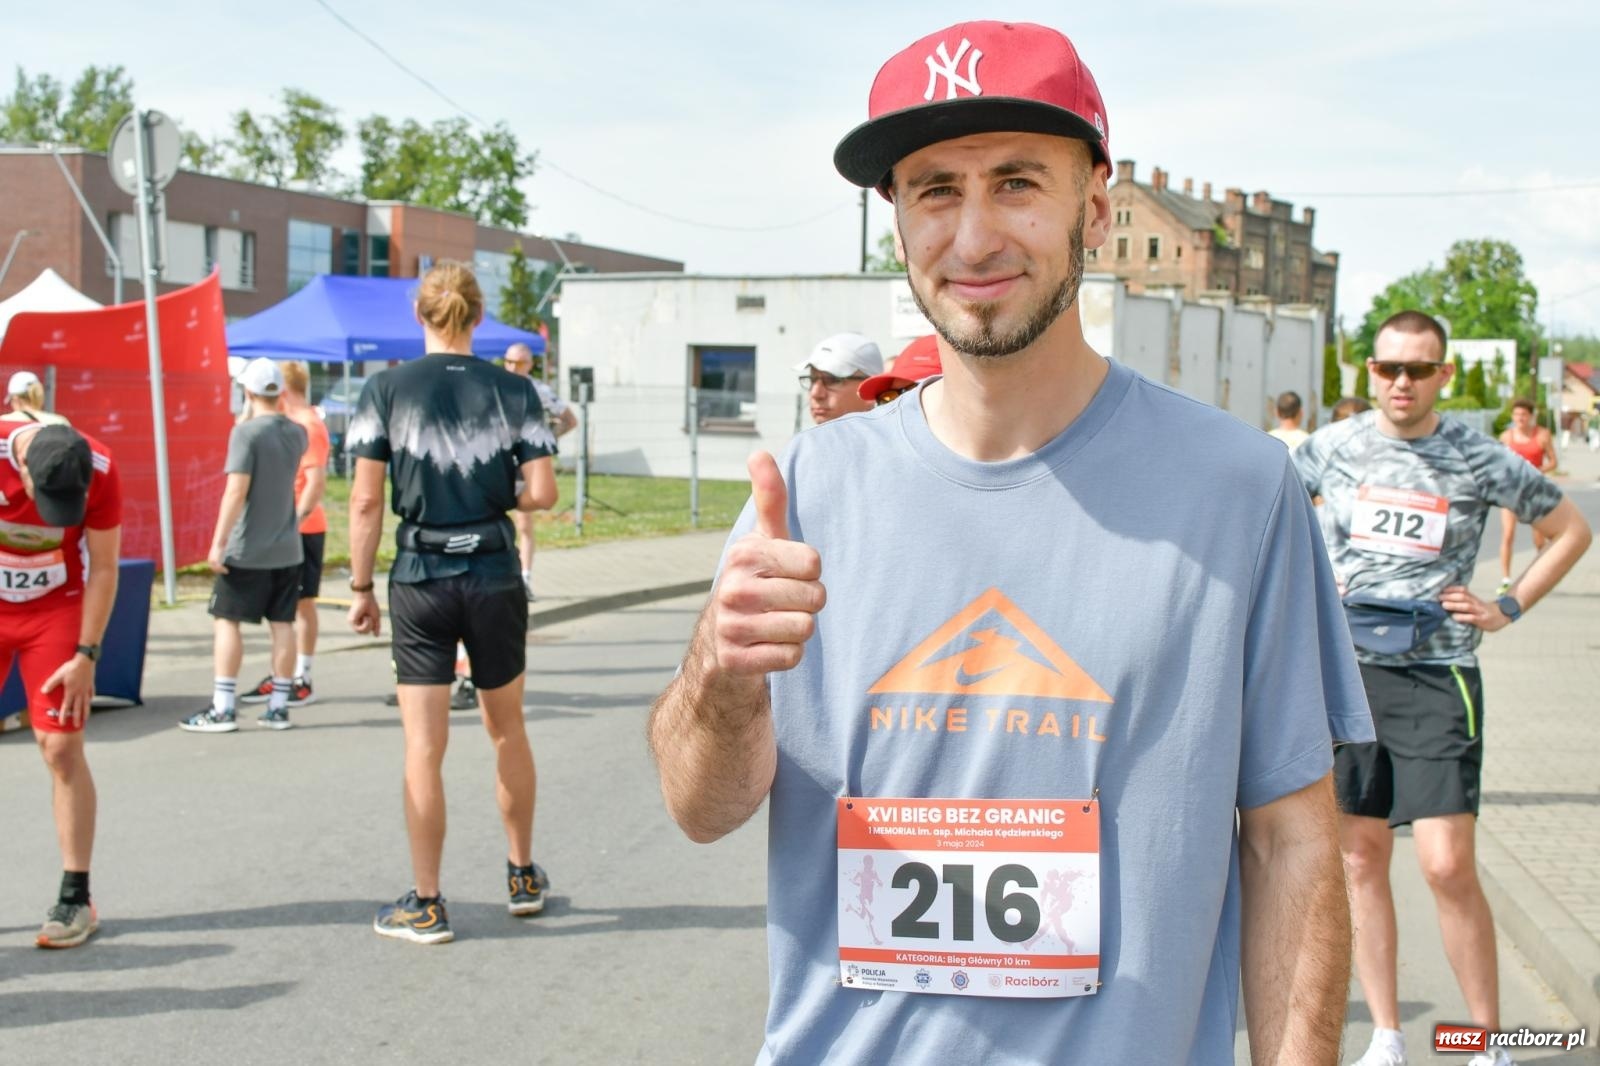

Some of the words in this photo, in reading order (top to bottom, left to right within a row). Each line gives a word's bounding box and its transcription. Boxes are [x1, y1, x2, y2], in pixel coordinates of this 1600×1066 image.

[1371, 509, 1424, 540] 212
[3, 570, 50, 589] 124
[870, 706, 969, 732] NIKE
[984, 708, 1107, 743] TRAIL
[867, 806, 898, 823] XVI
[901, 807, 942, 824] BIEG
[945, 808, 981, 824] BEZ
[985, 808, 1065, 825] GRANIC
[917, 826, 932, 836] im.
[933, 828, 953, 839] asp.
[954, 828, 993, 837] Michała
[994, 829, 1064, 840] Kędzierskiego
[964, 840, 985, 848] 2024
[891, 861, 1041, 943] 216
[896, 952, 946, 964] KATEGORIA:
[947, 956, 967, 966] Bieg
[967, 957, 1002, 967] Główny
[1003, 957, 1013, 966] 10
[1014, 957, 1031, 966] km
[861, 968, 886, 977] POLICJA
[1004, 976, 1060, 987] Racibórz
